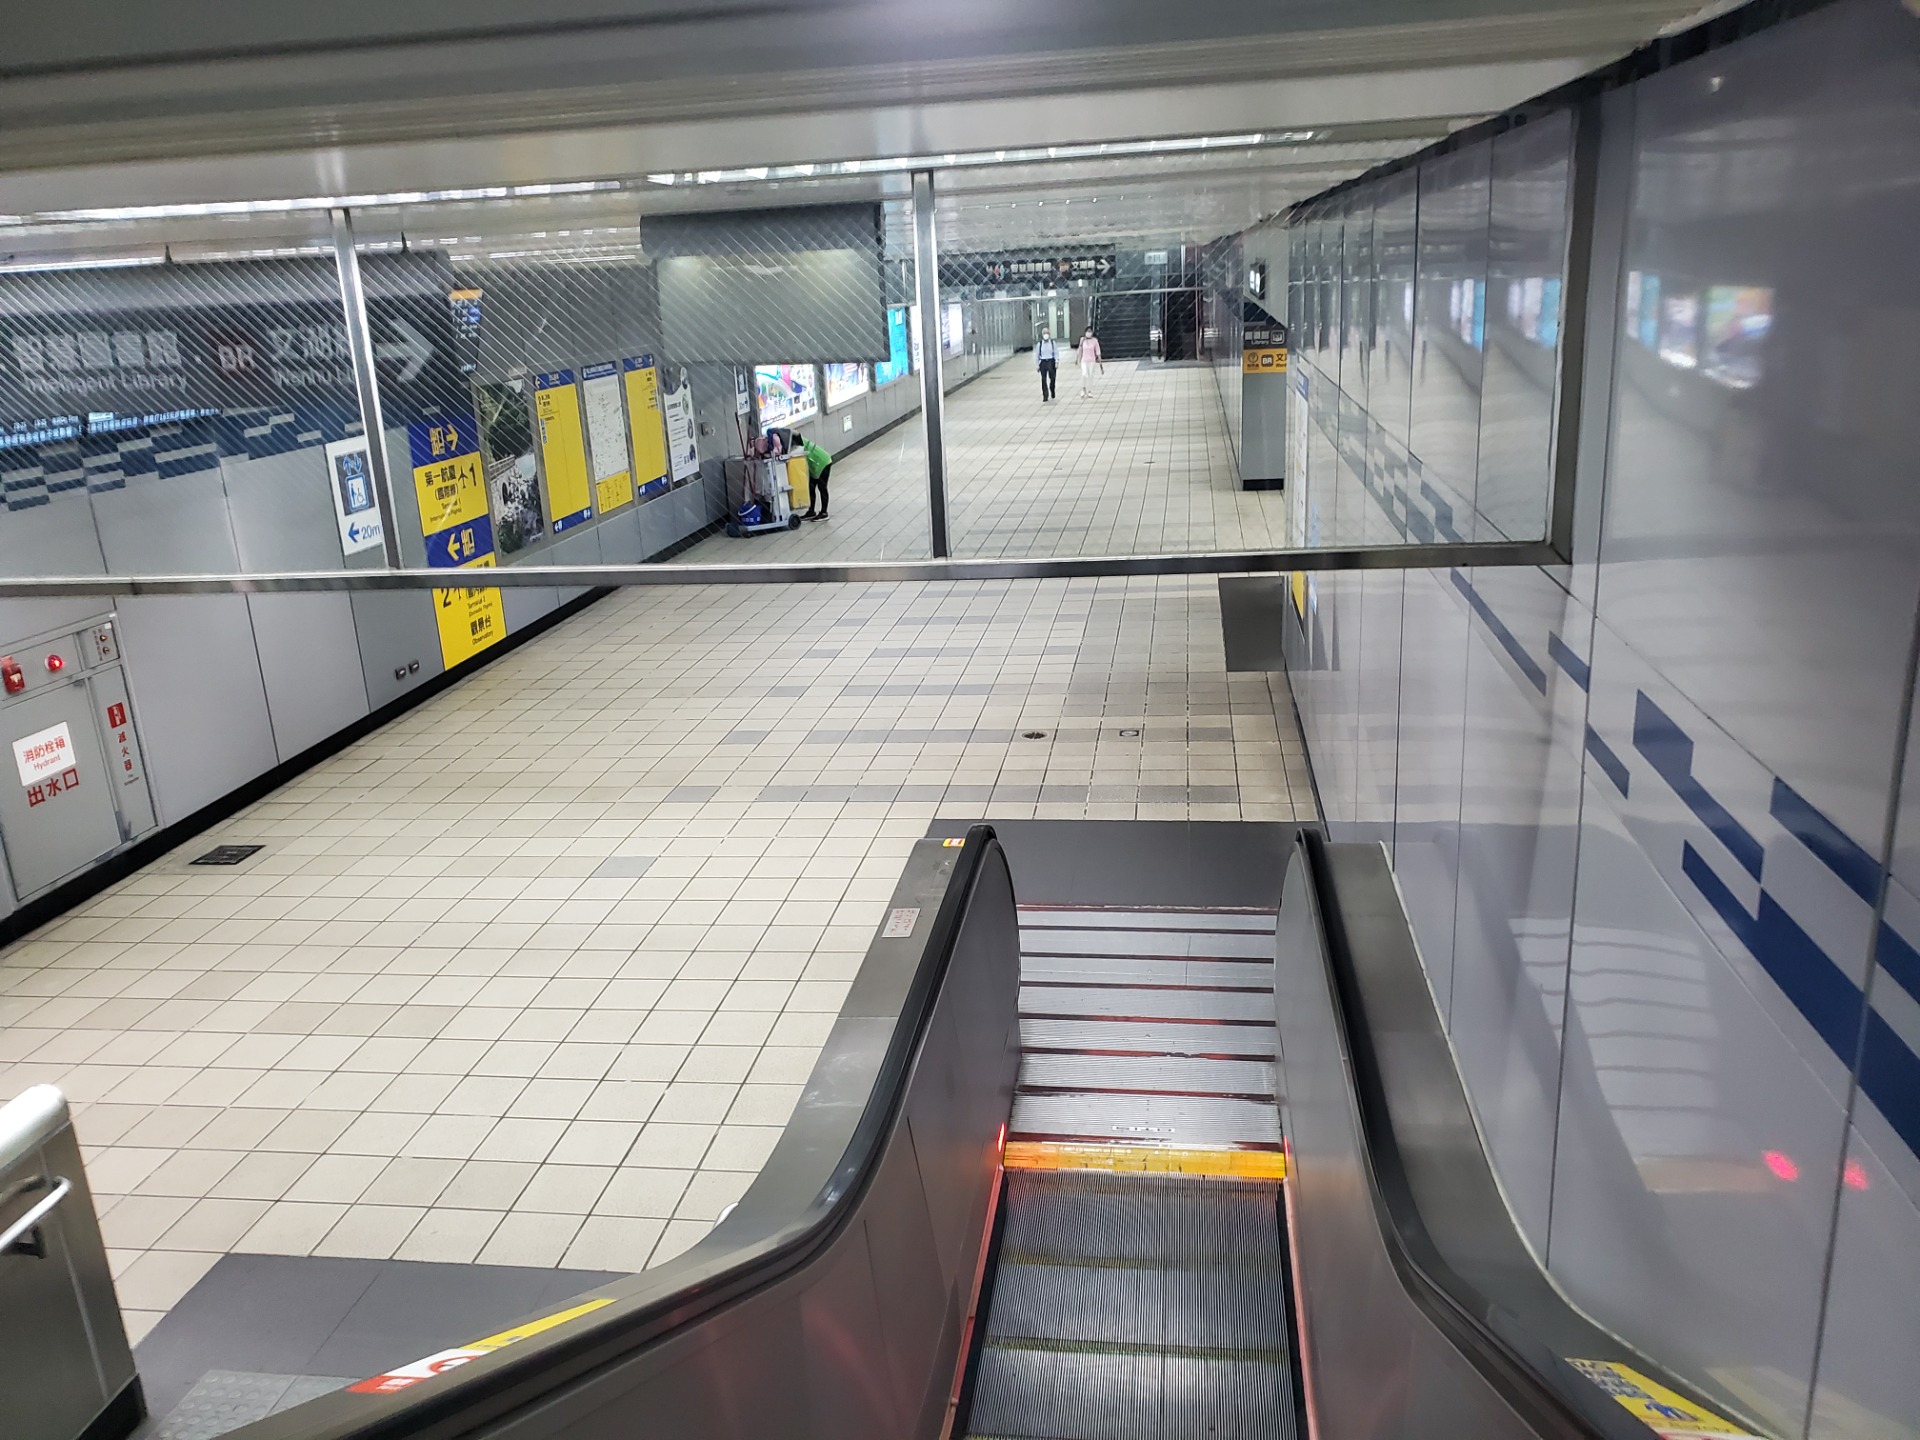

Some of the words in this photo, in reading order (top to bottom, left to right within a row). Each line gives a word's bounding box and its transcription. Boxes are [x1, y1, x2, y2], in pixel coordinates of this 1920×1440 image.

[1276, 353, 1287, 362] 文
[469, 463, 477, 487] 1
[361, 524, 380, 540] 20m
[441, 588, 452, 608] 2
[471, 630, 494, 645] Observatory
[22, 735, 66, 764] 消防栓箱
[33, 754, 61, 771] Hydrant
[27, 767, 80, 807] 出水口
